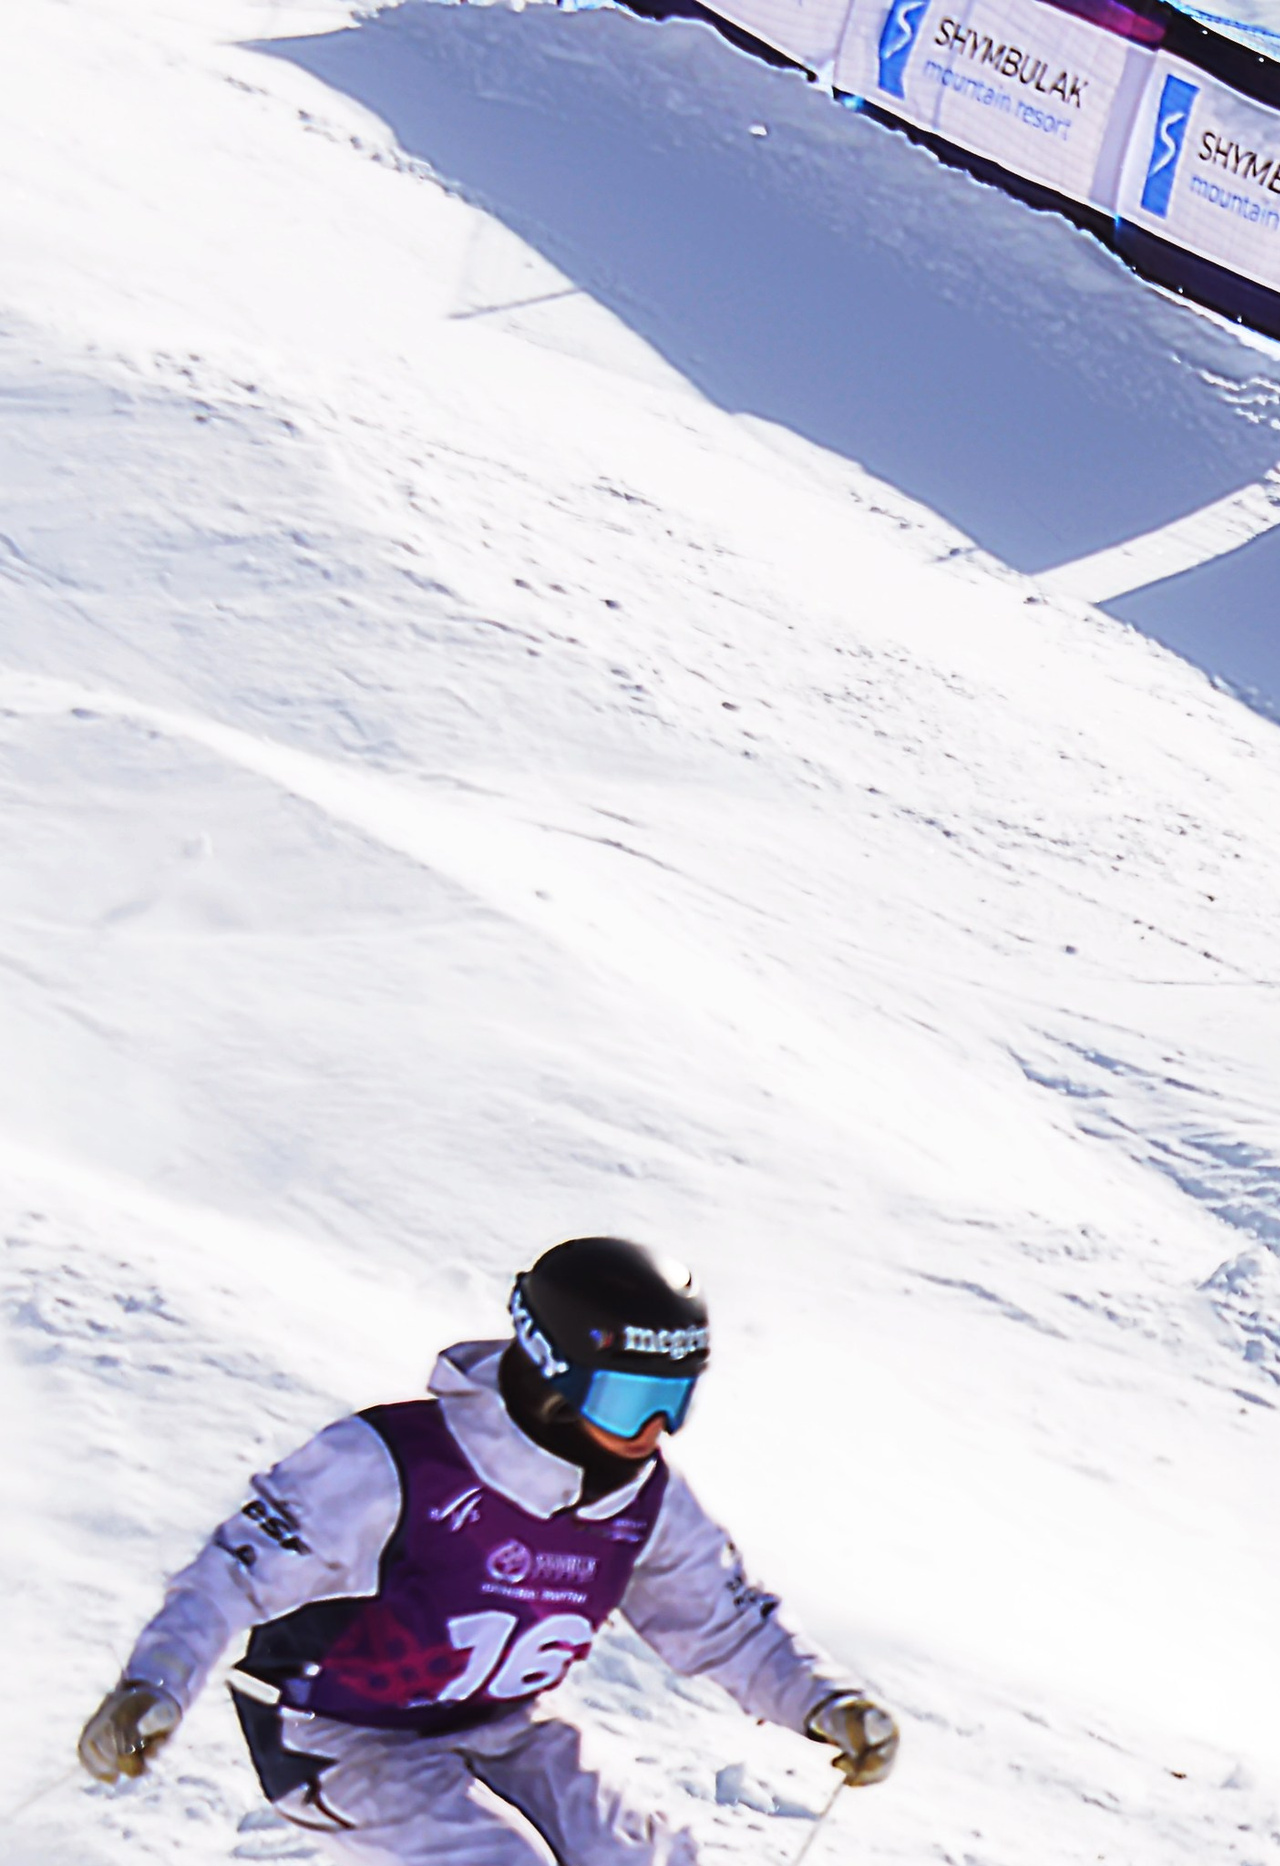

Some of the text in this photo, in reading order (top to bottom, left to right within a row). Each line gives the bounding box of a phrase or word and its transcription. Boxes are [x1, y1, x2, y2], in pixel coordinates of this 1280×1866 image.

[923, 60, 1072, 141] mountain resort
[934, 16, 1089, 108] SHYMBULAK
[1188, 174, 1280, 230] mountain
[437, 1610, 593, 1700] 16
